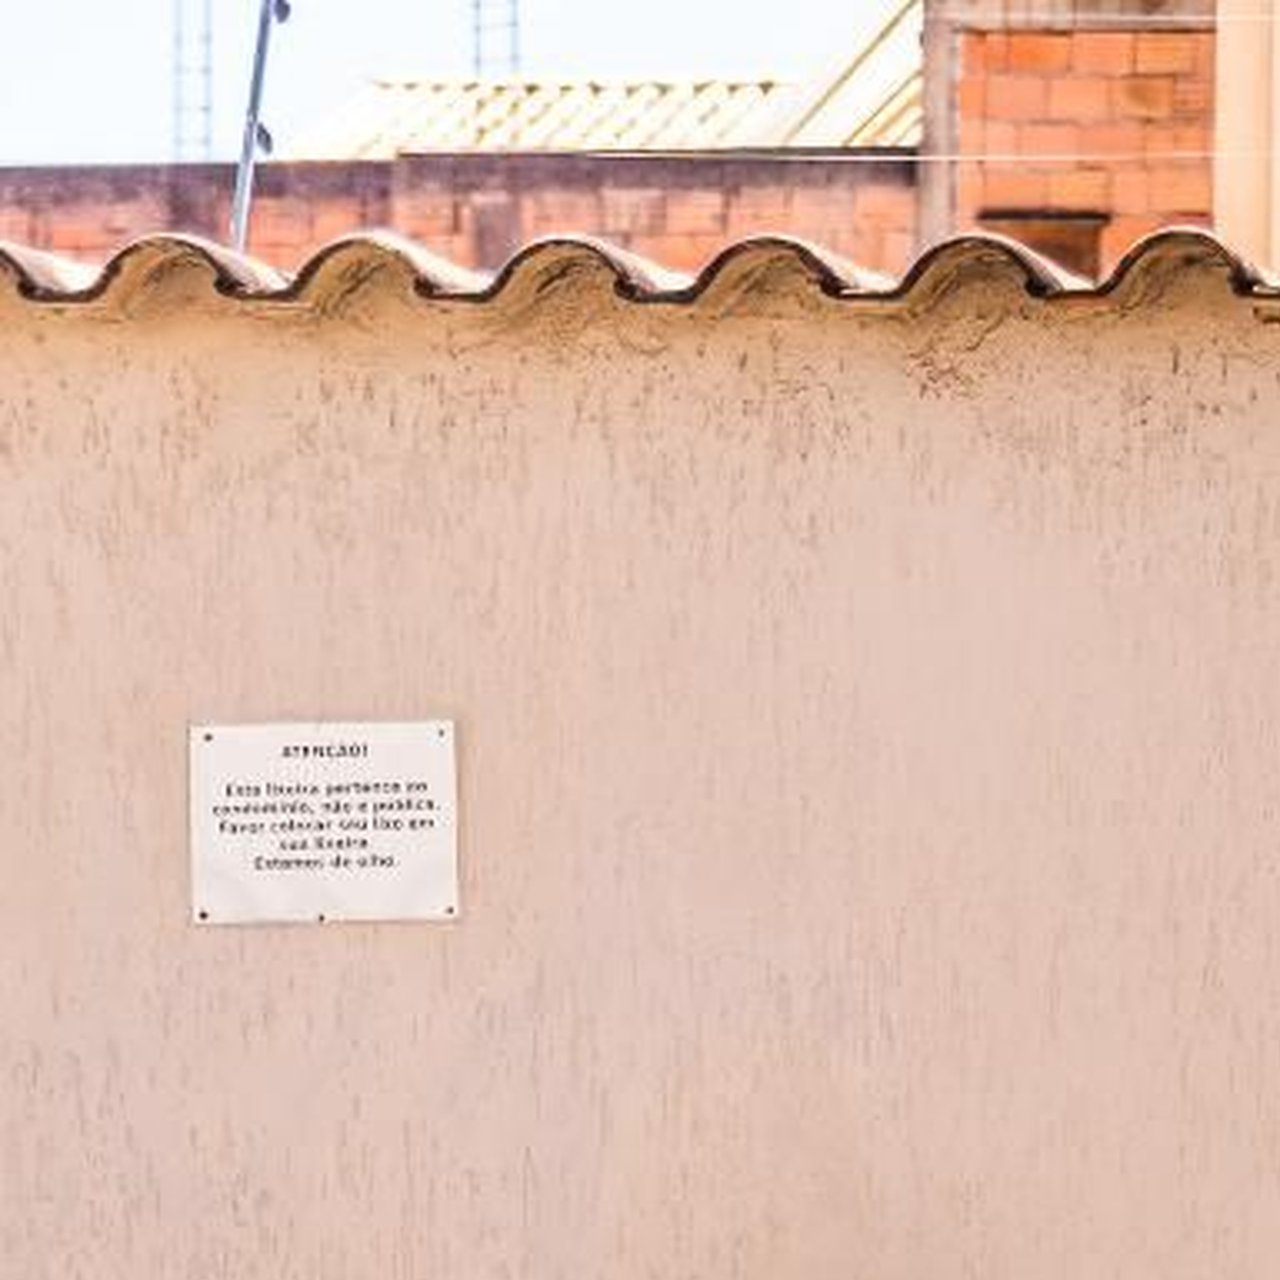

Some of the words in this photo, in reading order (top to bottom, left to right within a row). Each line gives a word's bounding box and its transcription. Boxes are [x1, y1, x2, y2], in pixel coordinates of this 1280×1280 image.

[325, 781, 401, 798] pertence
[219, 819, 265, 835] Favor
[270, 818, 332, 833] colocar
[372, 816, 404, 831] lixo
[330, 854, 355, 869] de
